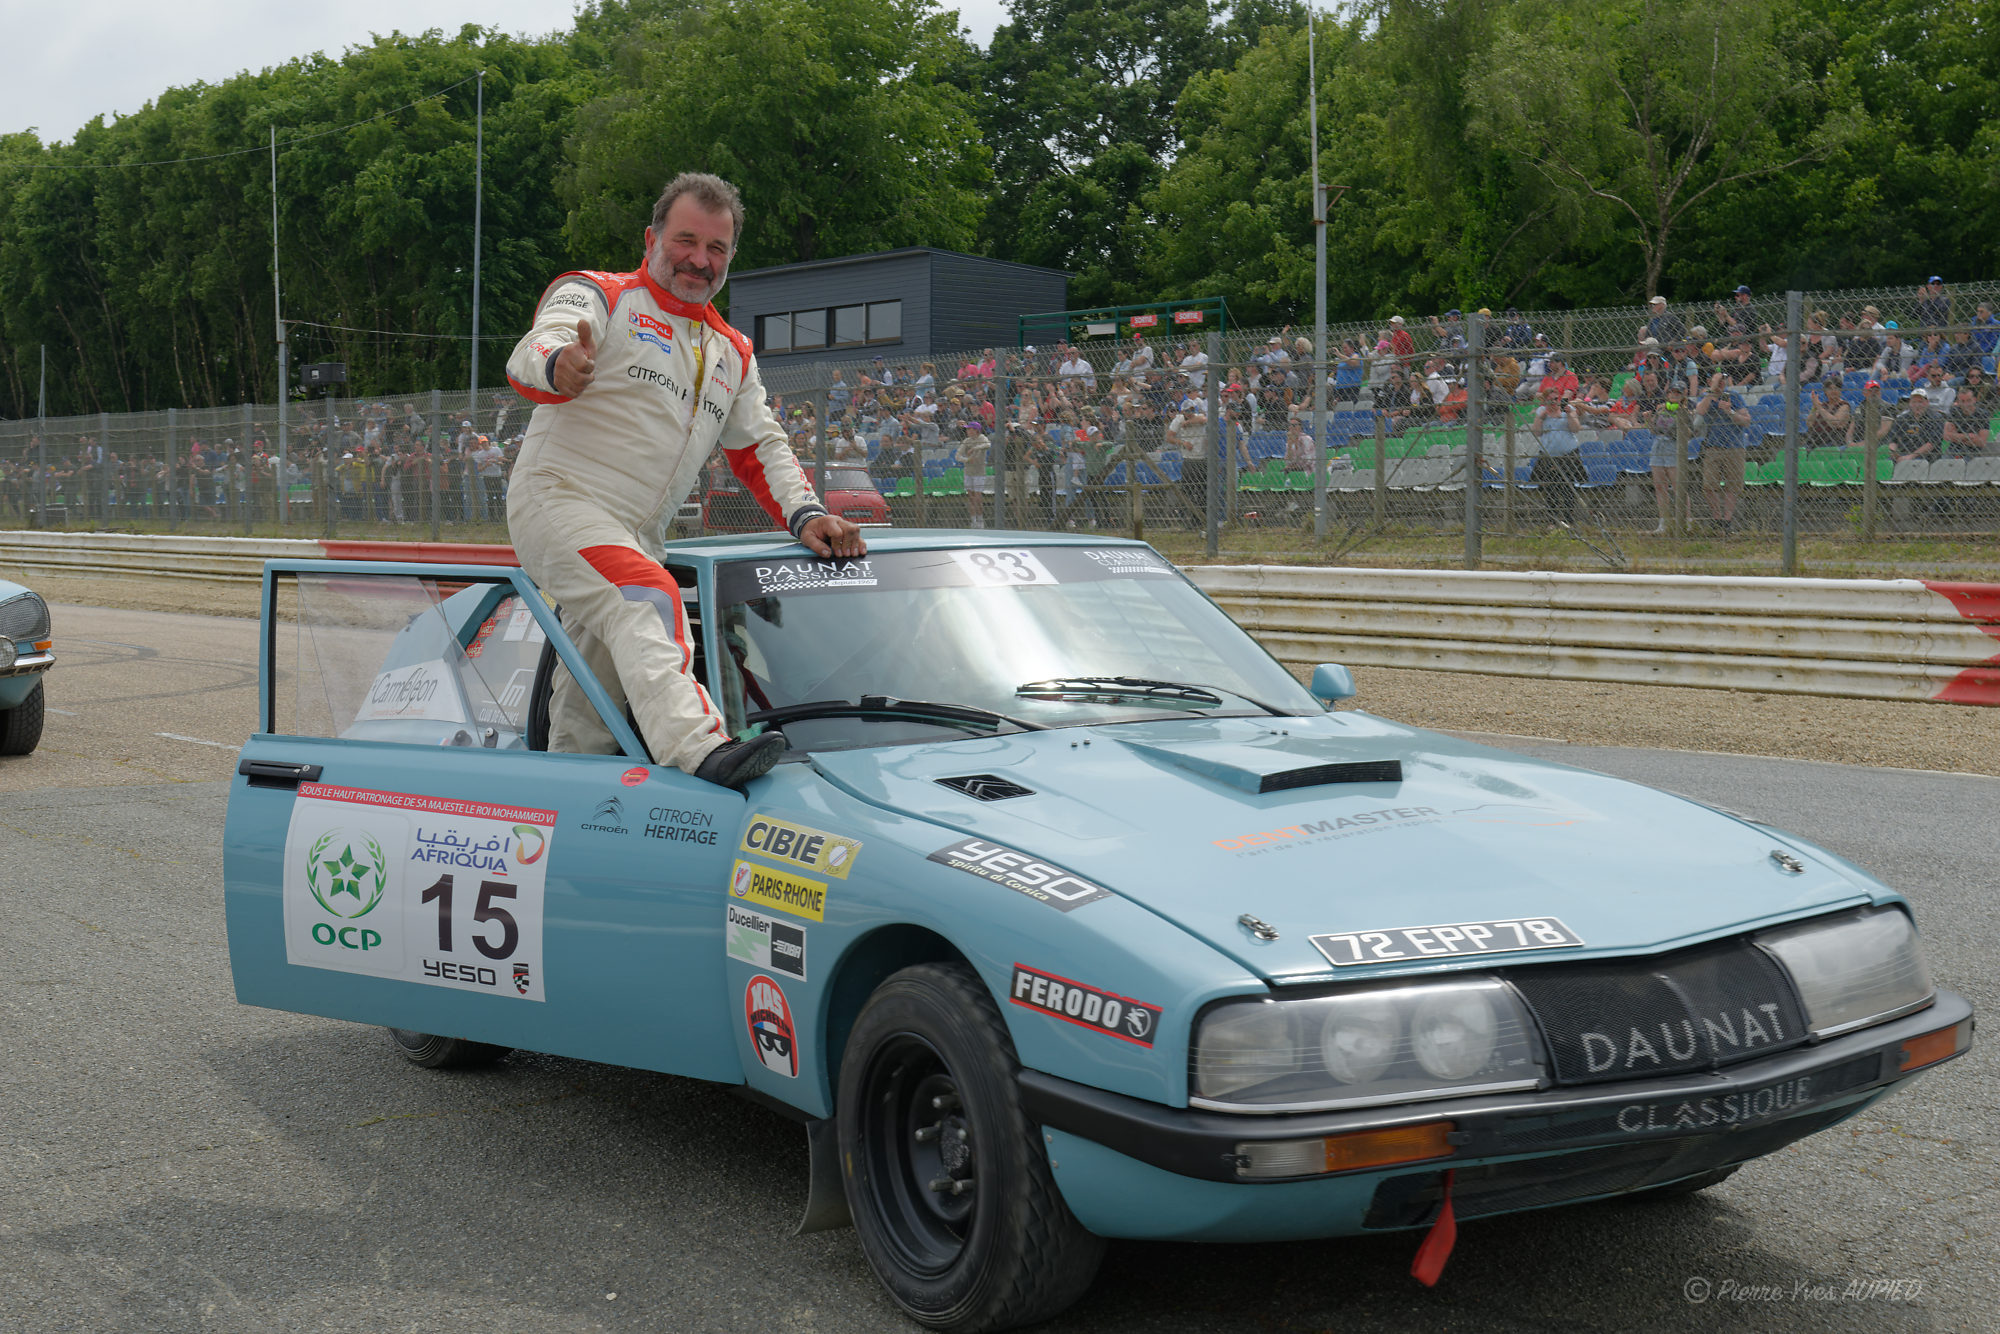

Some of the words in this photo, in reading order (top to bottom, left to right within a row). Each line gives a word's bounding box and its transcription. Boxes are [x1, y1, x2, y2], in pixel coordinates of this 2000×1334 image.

[640, 316, 671, 337] TOTAL
[641, 333, 671, 354] MICHELIN
[627, 365, 679, 396] CITROËN
[755, 560, 873, 578] DAUNAT
[758, 570, 874, 585] CLASSIQUE
[970, 551, 1037, 583] 83
[301, 785, 323, 796] SOUS
[323, 787, 332, 797] LE
[333, 788, 356, 800] HAUT
[356, 791, 403, 806] PATRONAGE
[403, 797, 417, 808] DE
[417, 798, 428, 809] SA
[428, 800, 464, 814] MAJESTE
[465, 804, 476, 815] LE
[476, 805, 492, 816] ROI
[491, 807, 546, 823] MOHAMMED
[546, 813, 555, 824] VI
[649, 807, 713, 827] CITROËN
[644, 824, 719, 846] HERITAGE
[746, 821, 826, 865] CIBIÉ
[1210, 806, 1442, 851] DENTMASTER
[411, 847, 508, 873] AFRIQUIA
[947, 841, 1099, 901] YESO
[947, 858, 990, 877] spiritu
[990, 873, 1005, 882] di
[1005, 879, 1049, 901] Corsica
[421, 873, 519, 961] 15
[729, 907, 770, 934] Ducellier
[311, 922, 382, 951] OCP
[1329, 932, 1404, 960] 72
[1402, 924, 1494, 955] EPP
[1493, 919, 1568, 946] 78
[423, 959, 497, 986] YESO
[1014, 971, 1123, 1029] FERODO
[750, 1009, 792, 1038] MICHELIN
[1581, 1003, 1785, 1073] DAUNAT
[1616, 1076, 1813, 1133] CLASSIQUE
